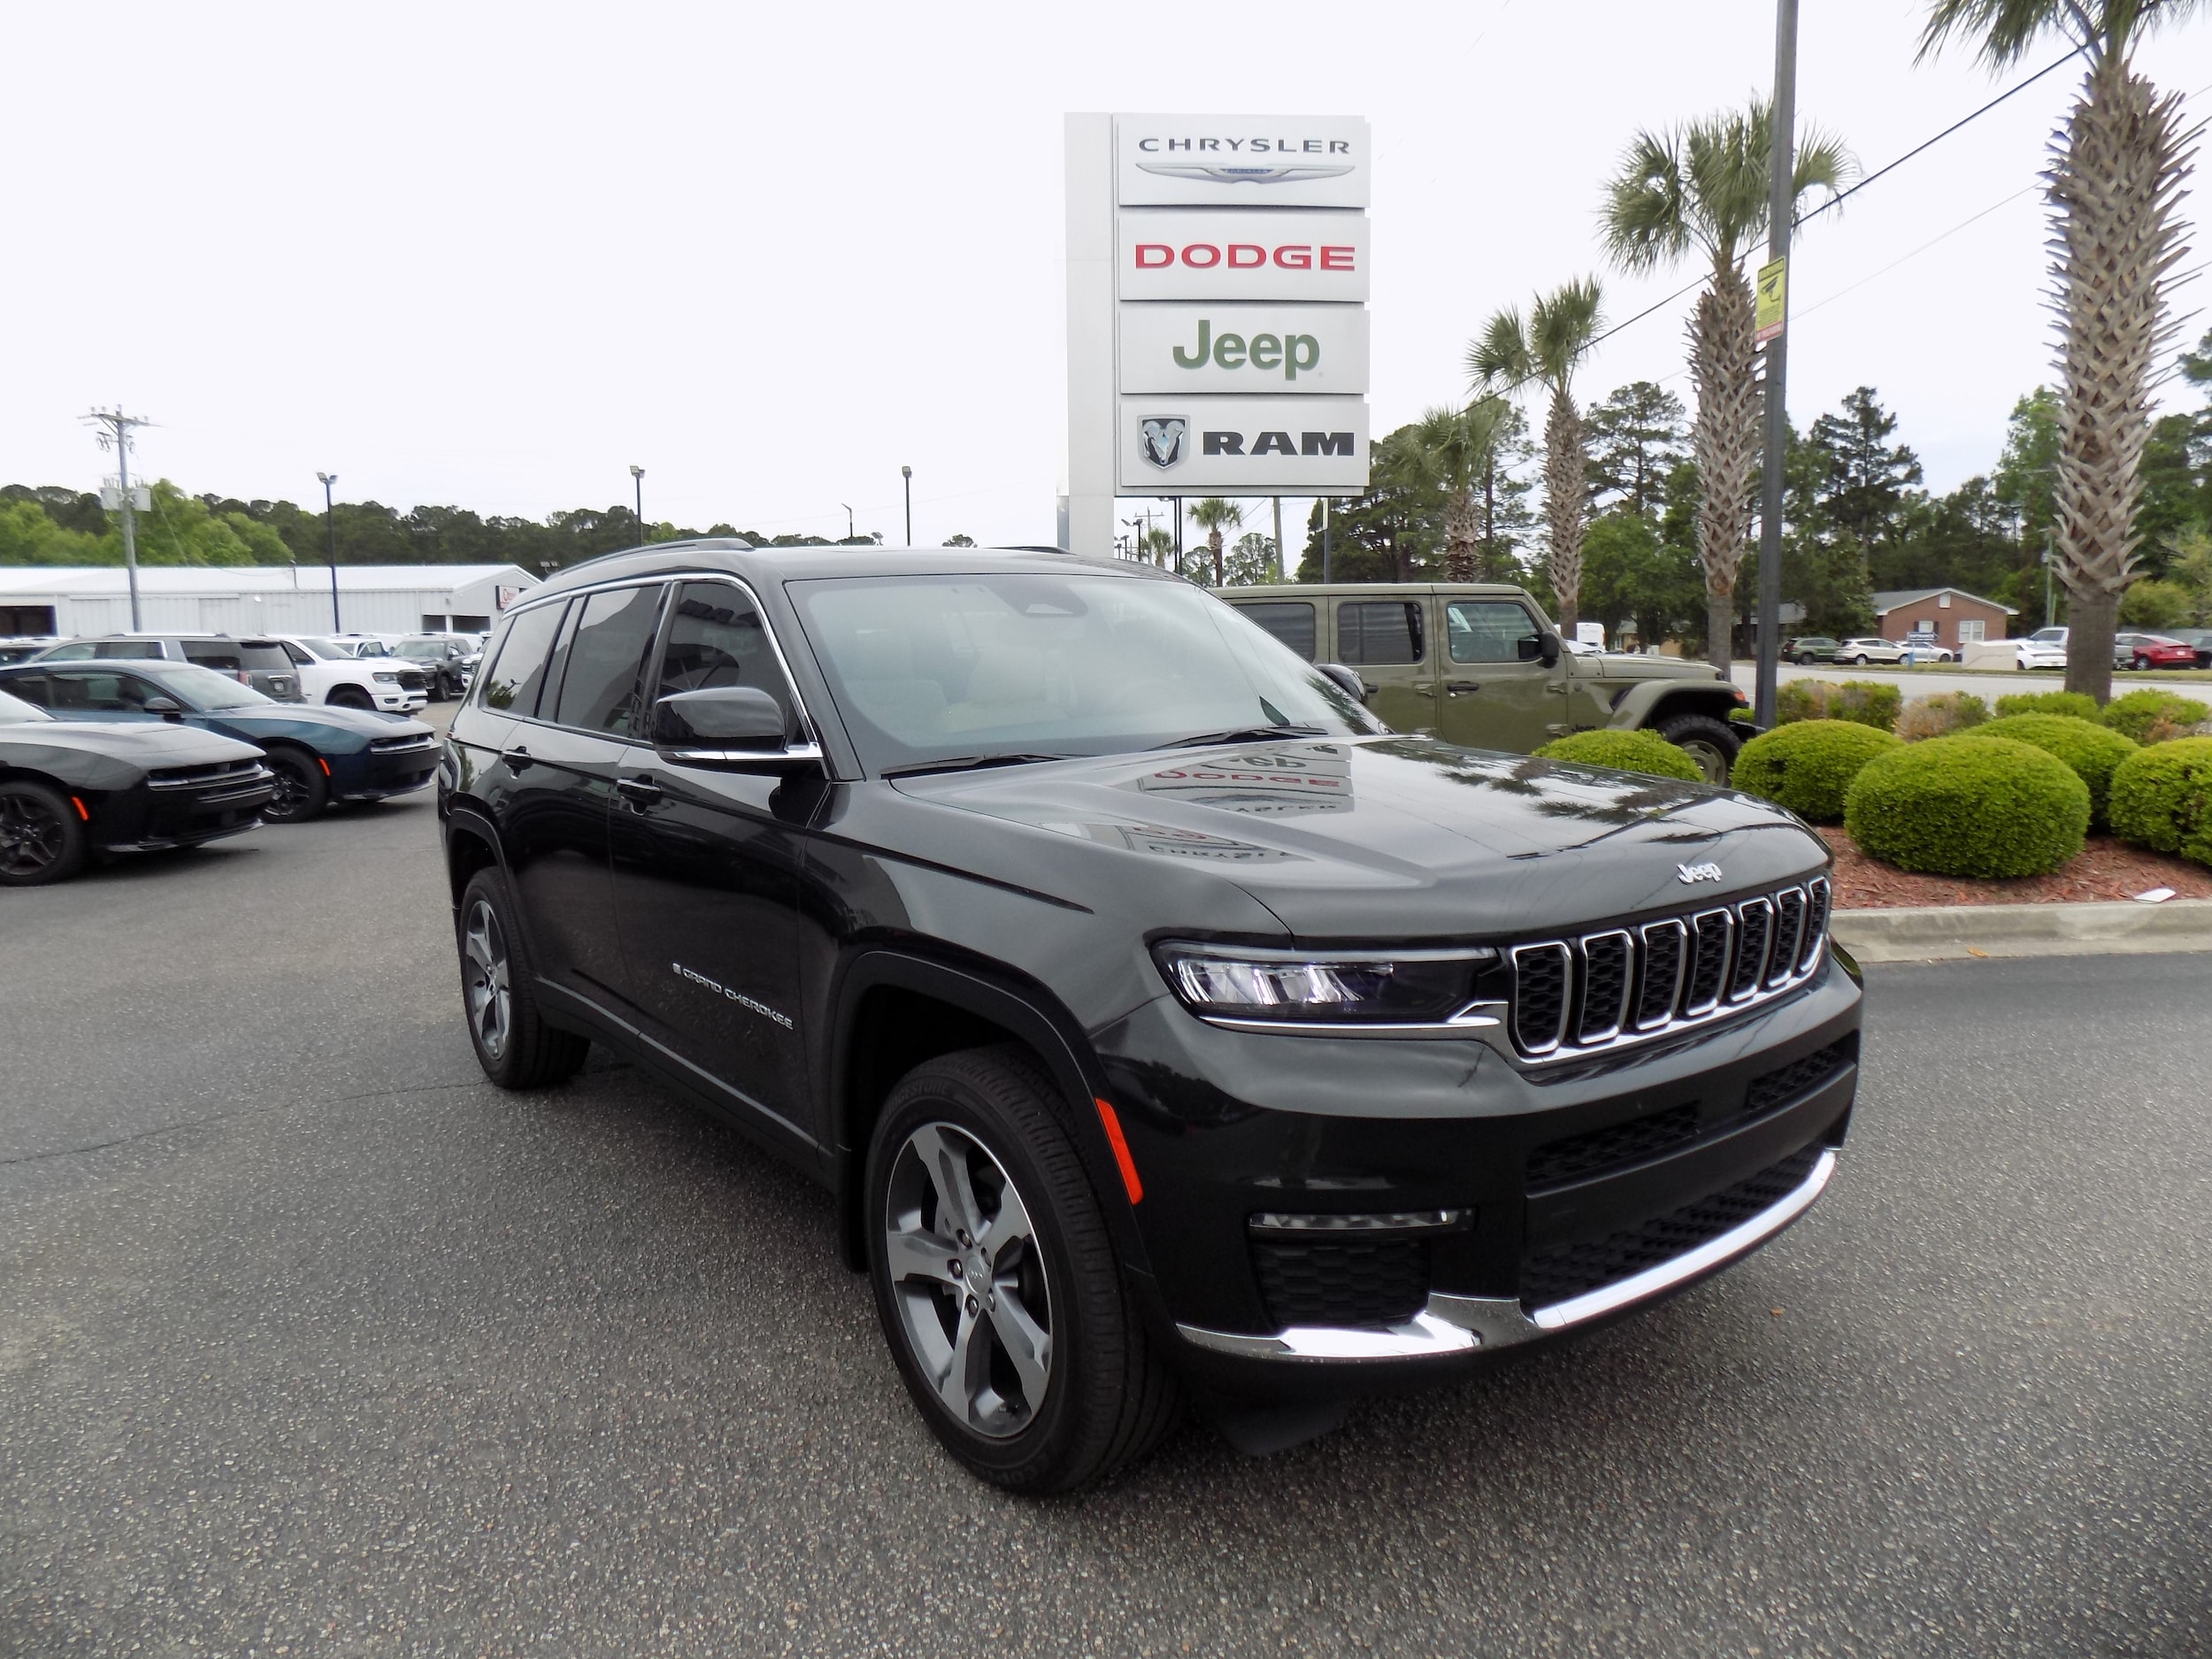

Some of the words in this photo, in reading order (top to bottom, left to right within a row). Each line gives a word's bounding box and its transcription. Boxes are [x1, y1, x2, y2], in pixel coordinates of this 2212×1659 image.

[1138, 138, 1351, 154] CHRYSLER
[1135, 243, 1356, 271] DODGE
[1172, 319, 1320, 380] Jeep
[1202, 431, 1356, 456] RAM
[1677, 863, 1722, 885] Jeep
[683, 968, 722, 993] GRAND
[725, 988, 794, 1030] CHEROKEE
